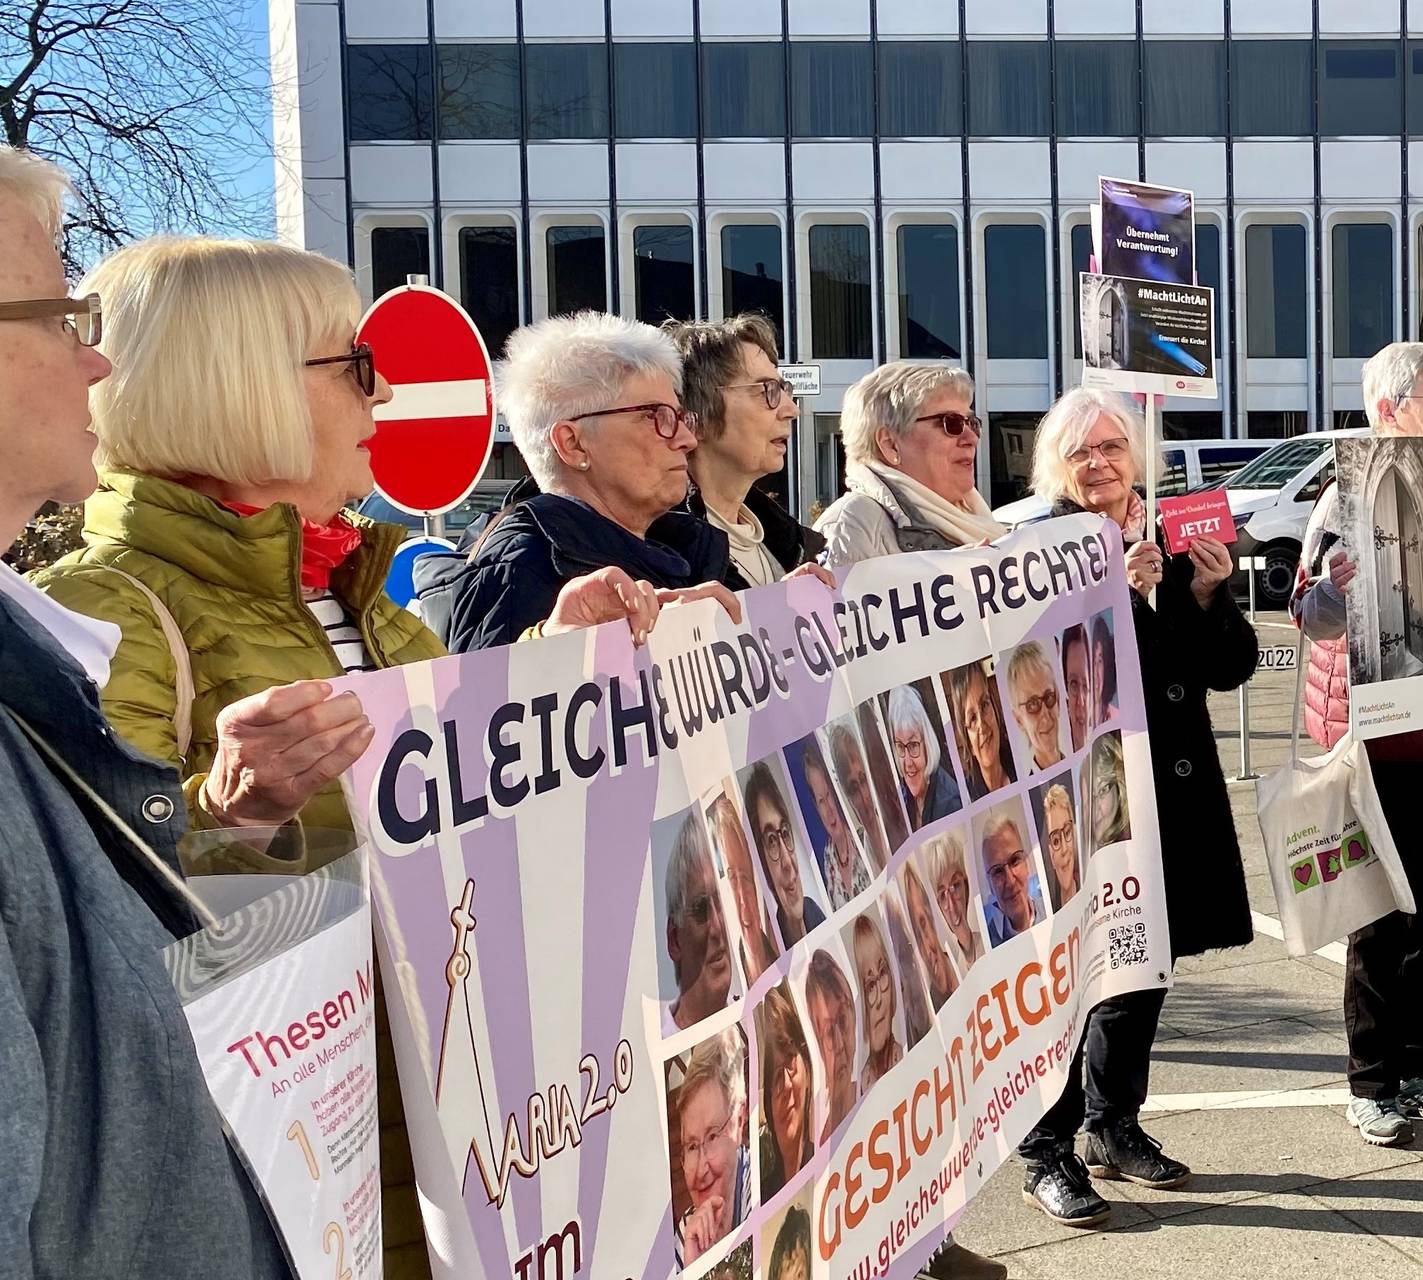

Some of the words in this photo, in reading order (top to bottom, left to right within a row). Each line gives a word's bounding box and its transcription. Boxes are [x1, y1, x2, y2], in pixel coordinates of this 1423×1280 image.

[1116, 239, 1178, 257] Verantwortung!
[1126, 226, 1170, 242] Übernehmt
[1138, 288, 1207, 306] #MachtLichtAn
[781, 370, 813, 379] Feuerwehr
[1180, 517, 1220, 538] JETZT
[378, 664, 678, 845] GLEICHE
[971, 532, 1108, 619] RECHTE!
[1286, 825, 1320, 847] Advent.
[1287, 842, 1314, 860] Höchste
[1315, 837, 1330, 847] Zeit
[1330, 833, 1342, 843] für
[1103, 876, 1141, 907] 2.0
[1112, 905, 1142, 920] Kirche
[227, 990, 356, 1078] Thesen
[271, 1080, 291, 1098] An
[293, 1060, 316, 1083] alle
[579, 1039, 634, 1127] 2.0
[287, 1120, 320, 1180] 1
[818, 1036, 965, 1261] GESICHT
[323, 1221, 352, 1280] 2
